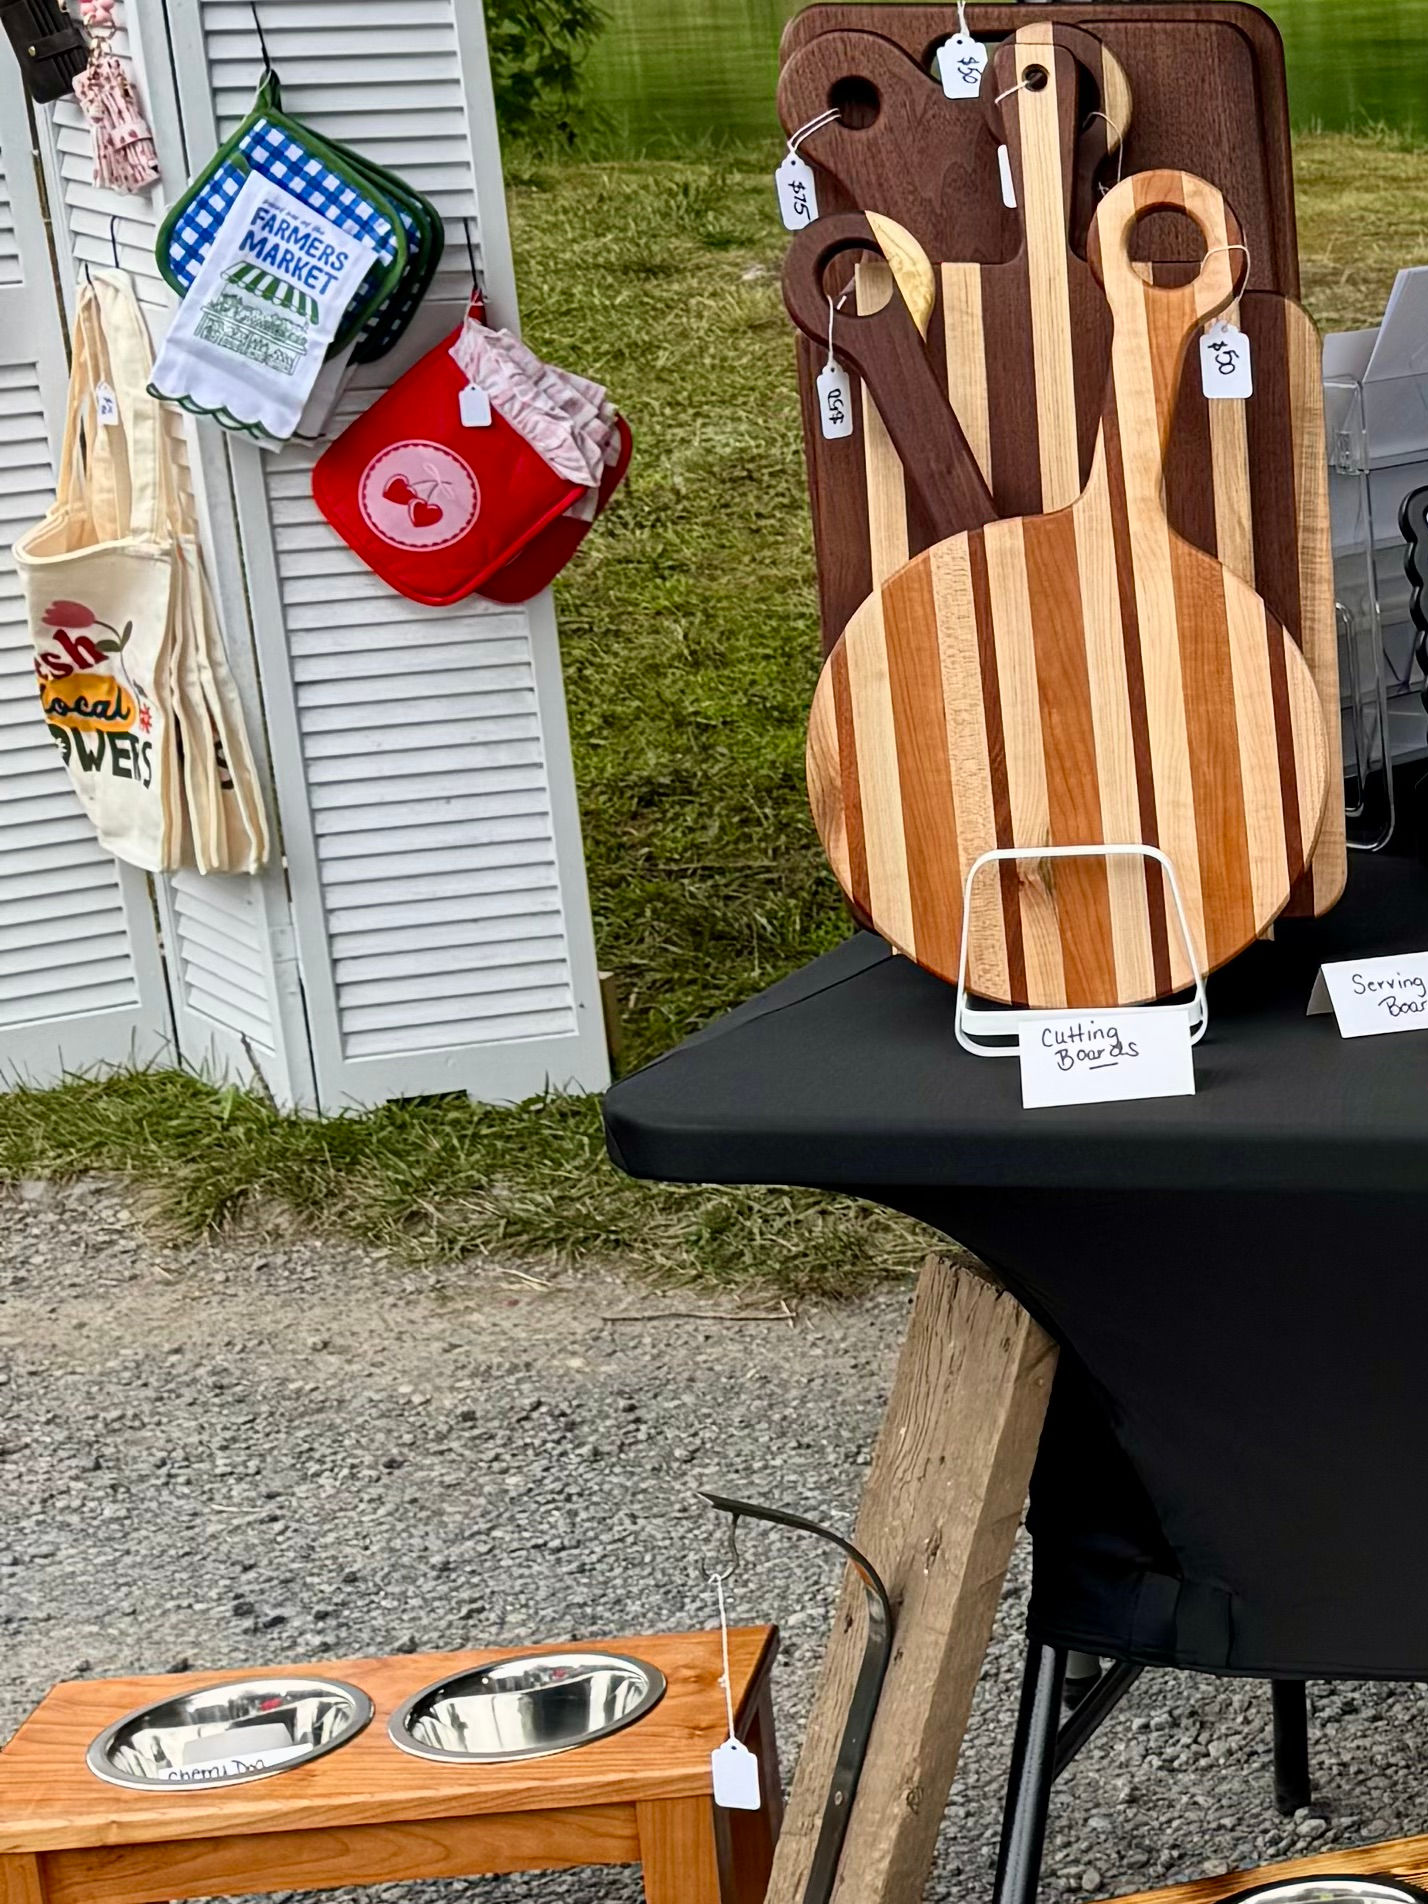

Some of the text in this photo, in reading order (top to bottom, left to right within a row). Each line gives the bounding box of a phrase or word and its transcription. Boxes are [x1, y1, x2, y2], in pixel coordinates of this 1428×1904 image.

[957, 56, 982, 84] $50
[788, 180, 811, 221] $75
[250, 206, 349, 272] FARMERS
[239, 230, 339, 295] MARKET
[1207, 341, 1240, 375] $50
[1352, 972, 1428, 999] Serving
[1040, 1023, 1122, 1054] Cutting
[1056, 1039, 1140, 1071] Boards
